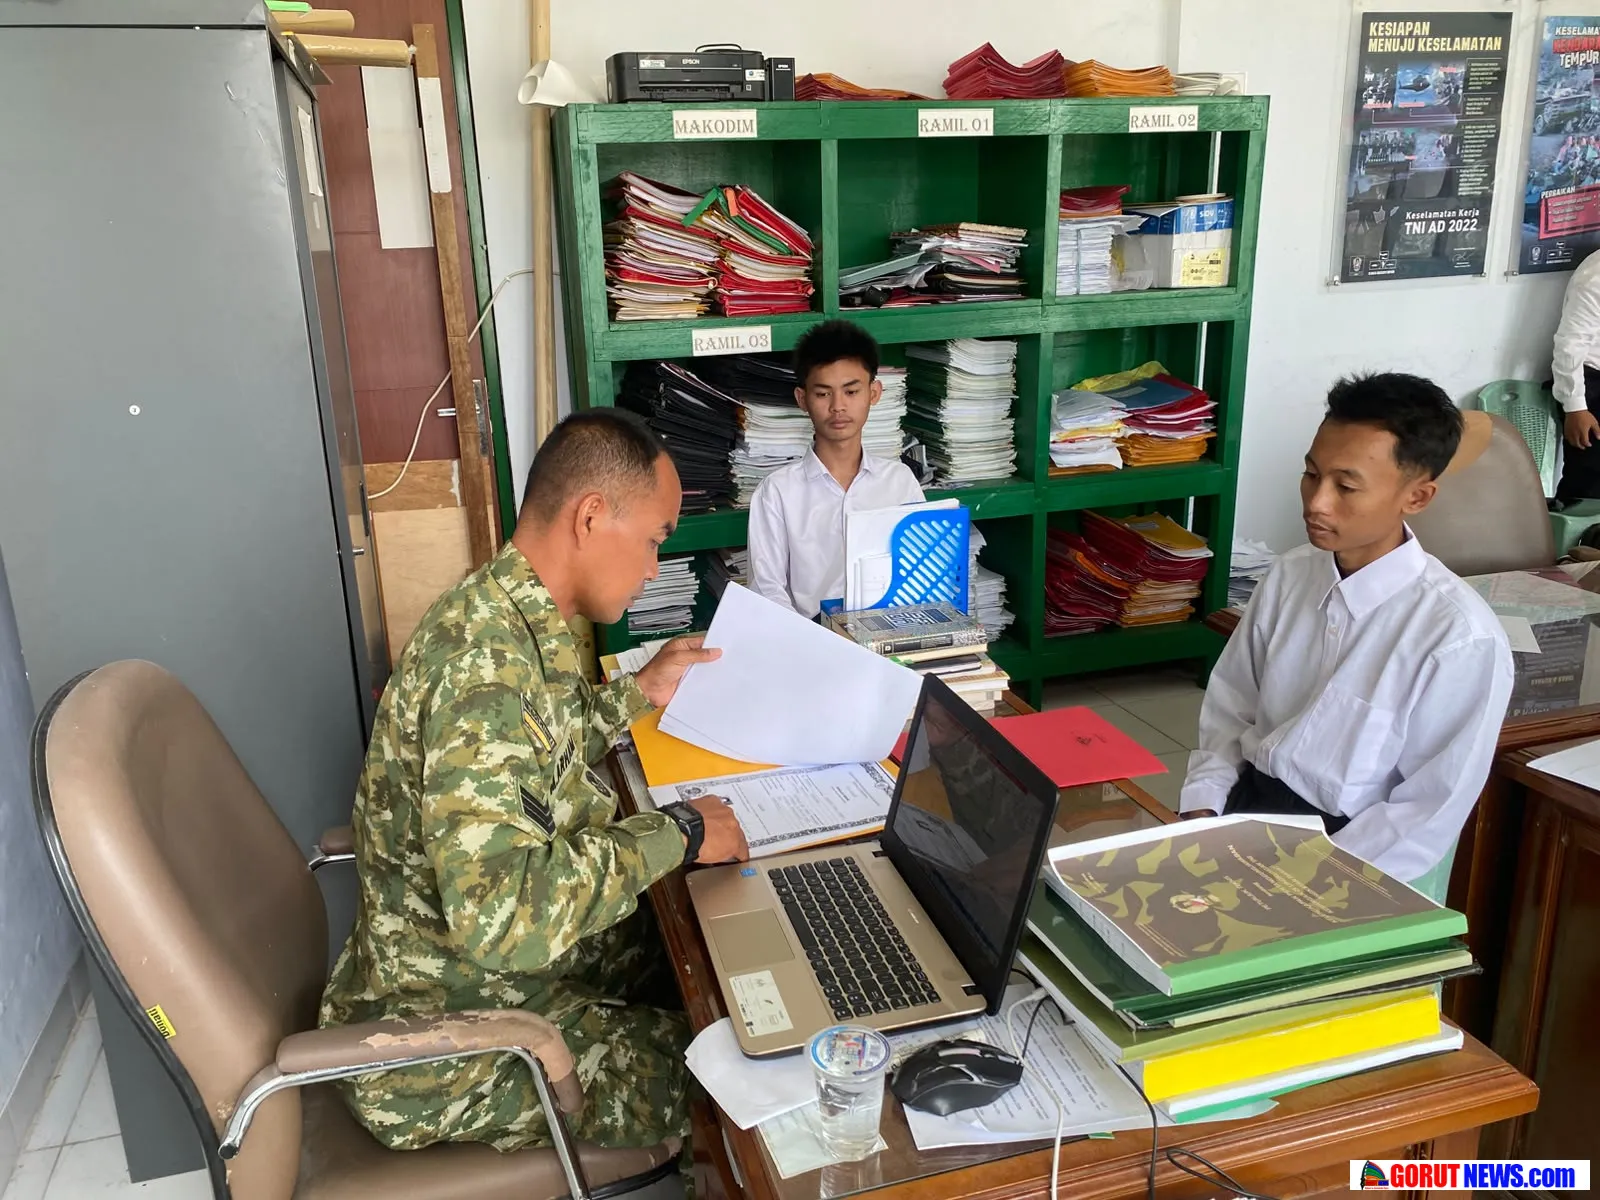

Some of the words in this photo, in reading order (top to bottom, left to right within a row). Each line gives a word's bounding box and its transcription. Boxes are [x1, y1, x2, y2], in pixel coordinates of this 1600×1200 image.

[1369, 22, 1430, 36] KESIAPAN
[1555, 26, 1600, 36] KESELAMA
[1368, 38, 1416, 53] MENUJU
[1417, 36, 1502, 52] KESELAMATAN
[1560, 50, 1599, 68] TEMPUR
[674, 118, 755, 134] MAKODIM
[919, 117, 967, 133] RAMIL
[971, 117, 990, 131] 01
[1130, 114, 1175, 128] RAMIL
[1177, 113, 1196, 127] 02
[1406, 209, 1456, 220] Keselamatan
[1458, 208, 1480, 219] Kerja
[1404, 221, 1426, 235] TNI
[1429, 221, 1446, 233] AD
[1449, 218, 1478, 232] 2022
[694, 336, 745, 352] RAMIL
[748, 334, 769, 349] 03
